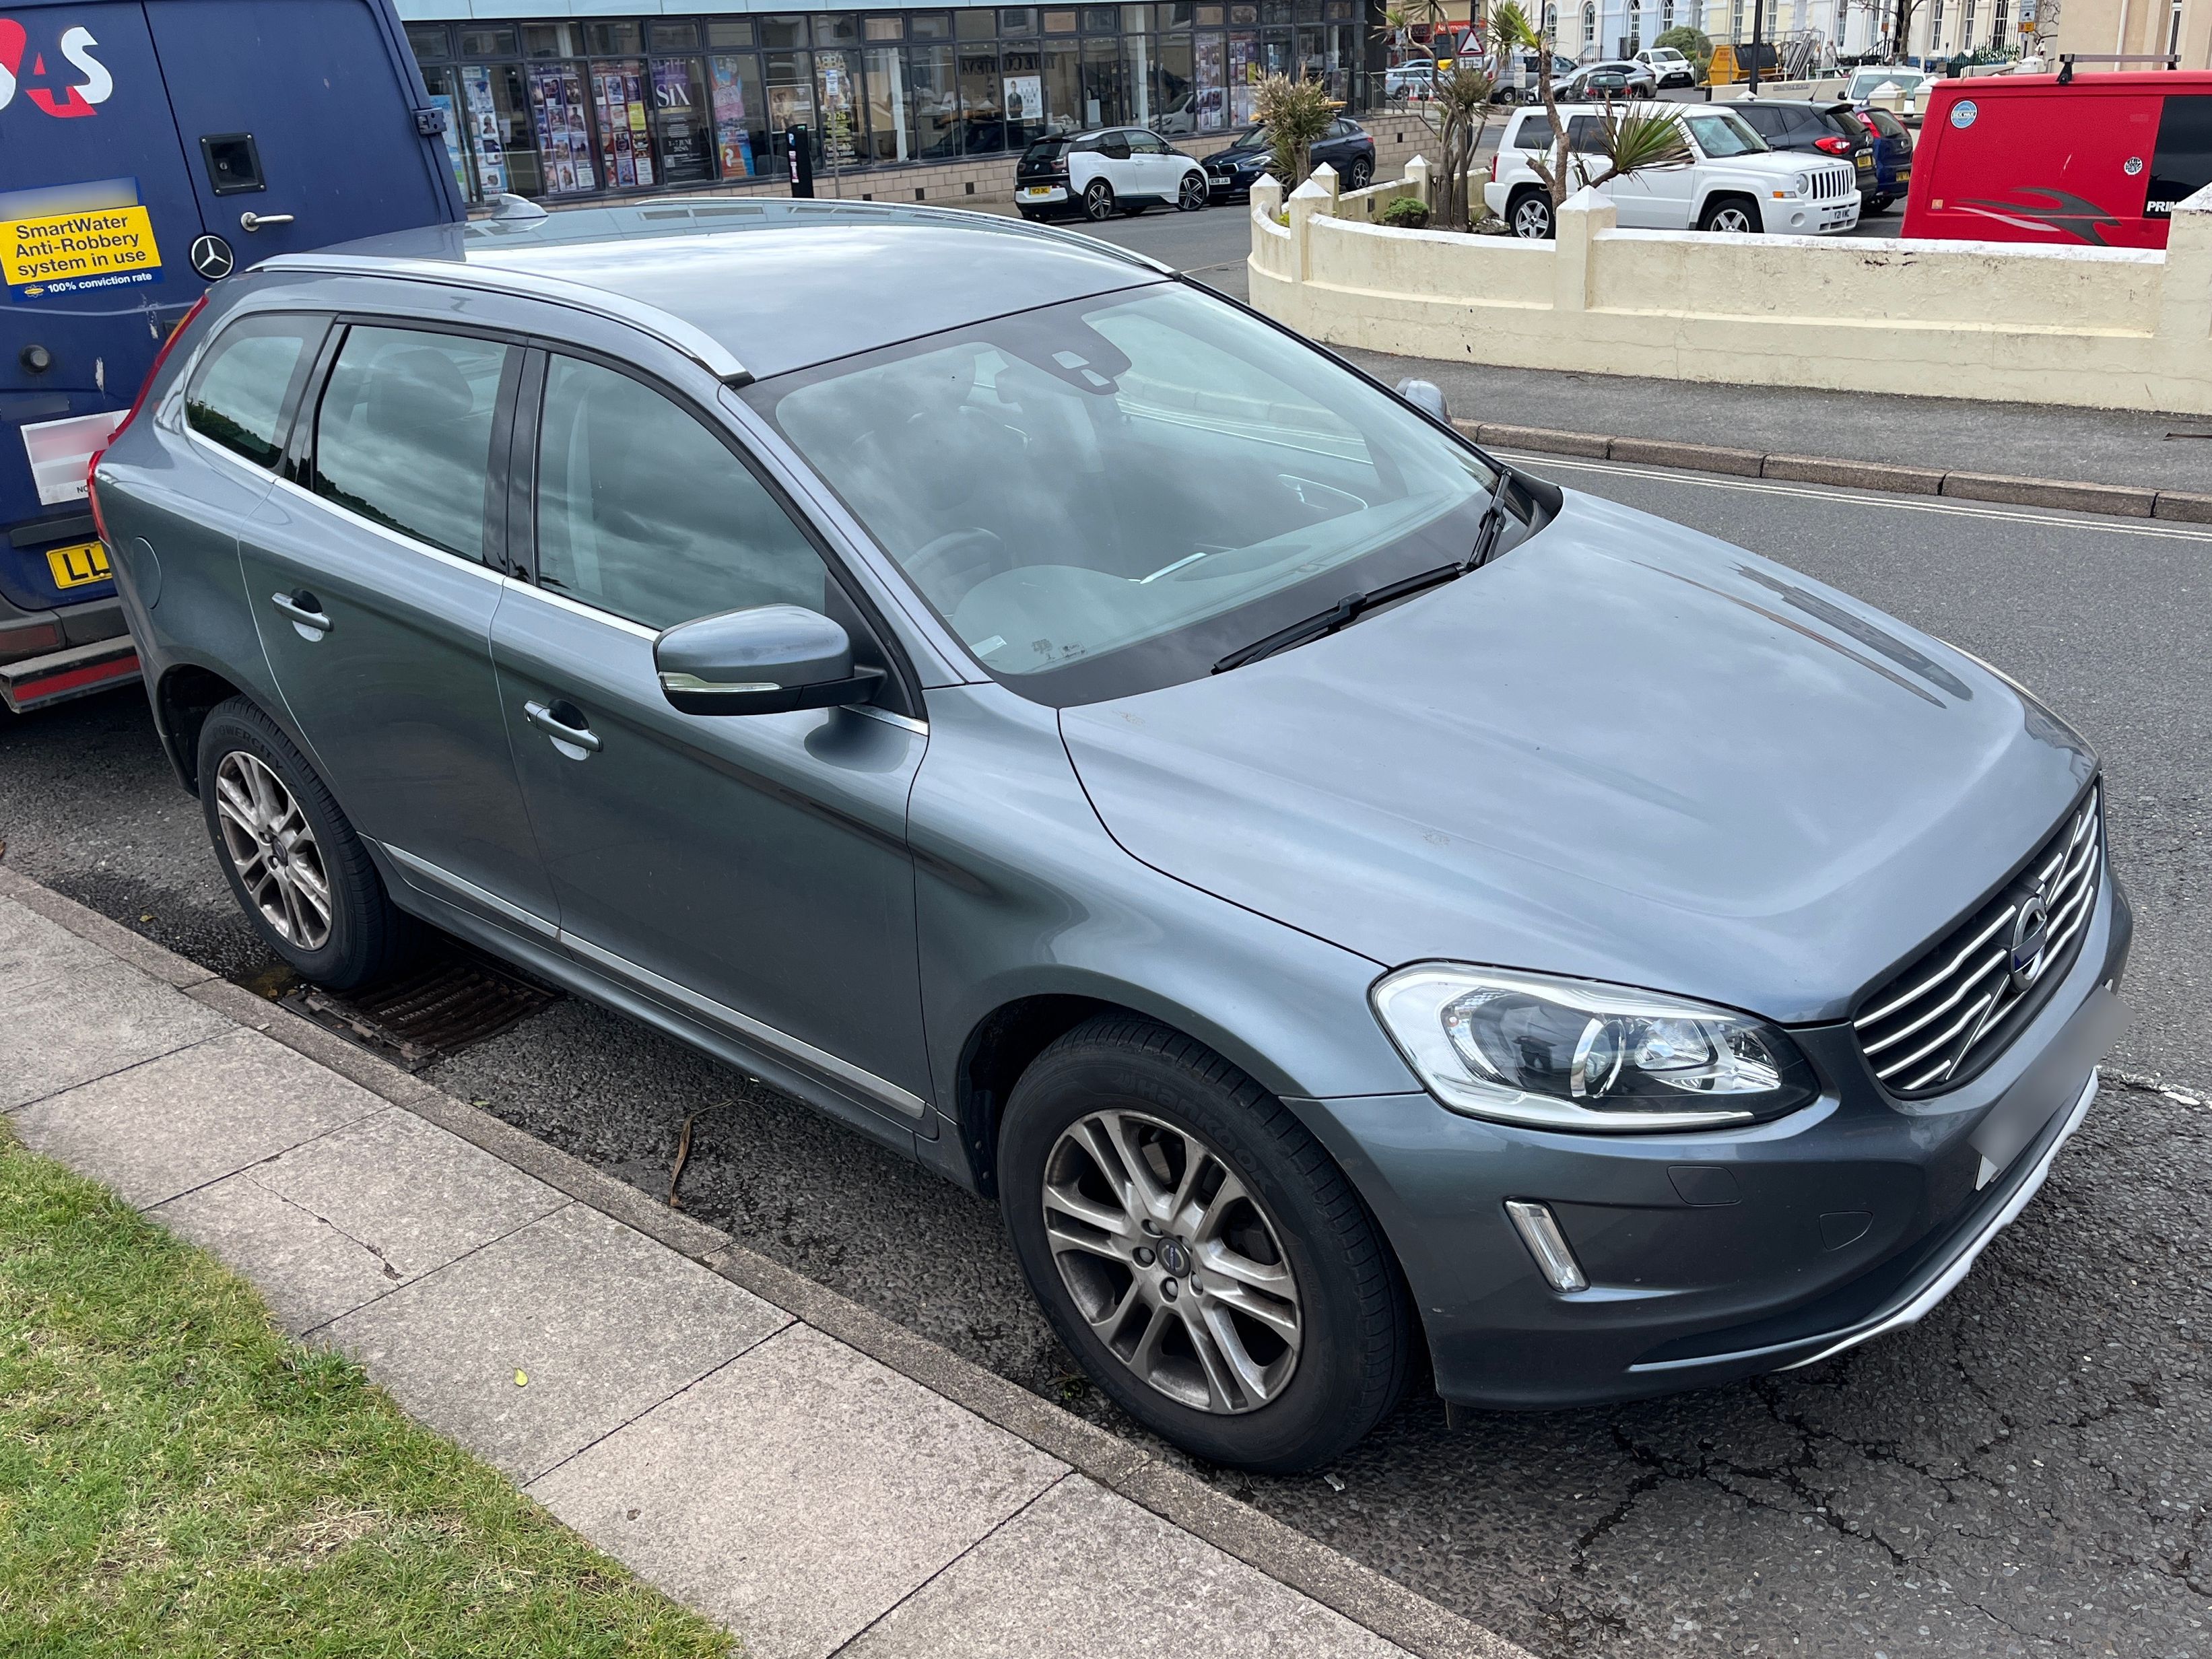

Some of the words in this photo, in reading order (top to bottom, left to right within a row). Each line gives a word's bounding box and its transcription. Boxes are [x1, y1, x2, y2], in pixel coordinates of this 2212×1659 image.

[16, 216, 128, 239] SmartWater
[16, 234, 139, 258] Anti-Robbery
[18, 257, 87, 277] system
[92, 252, 109, 267] in
[114, 250, 146, 264] use
[47, 281, 76, 293] 100%
[79, 275, 131, 289] conviction
[132, 272, 153, 282] rate
